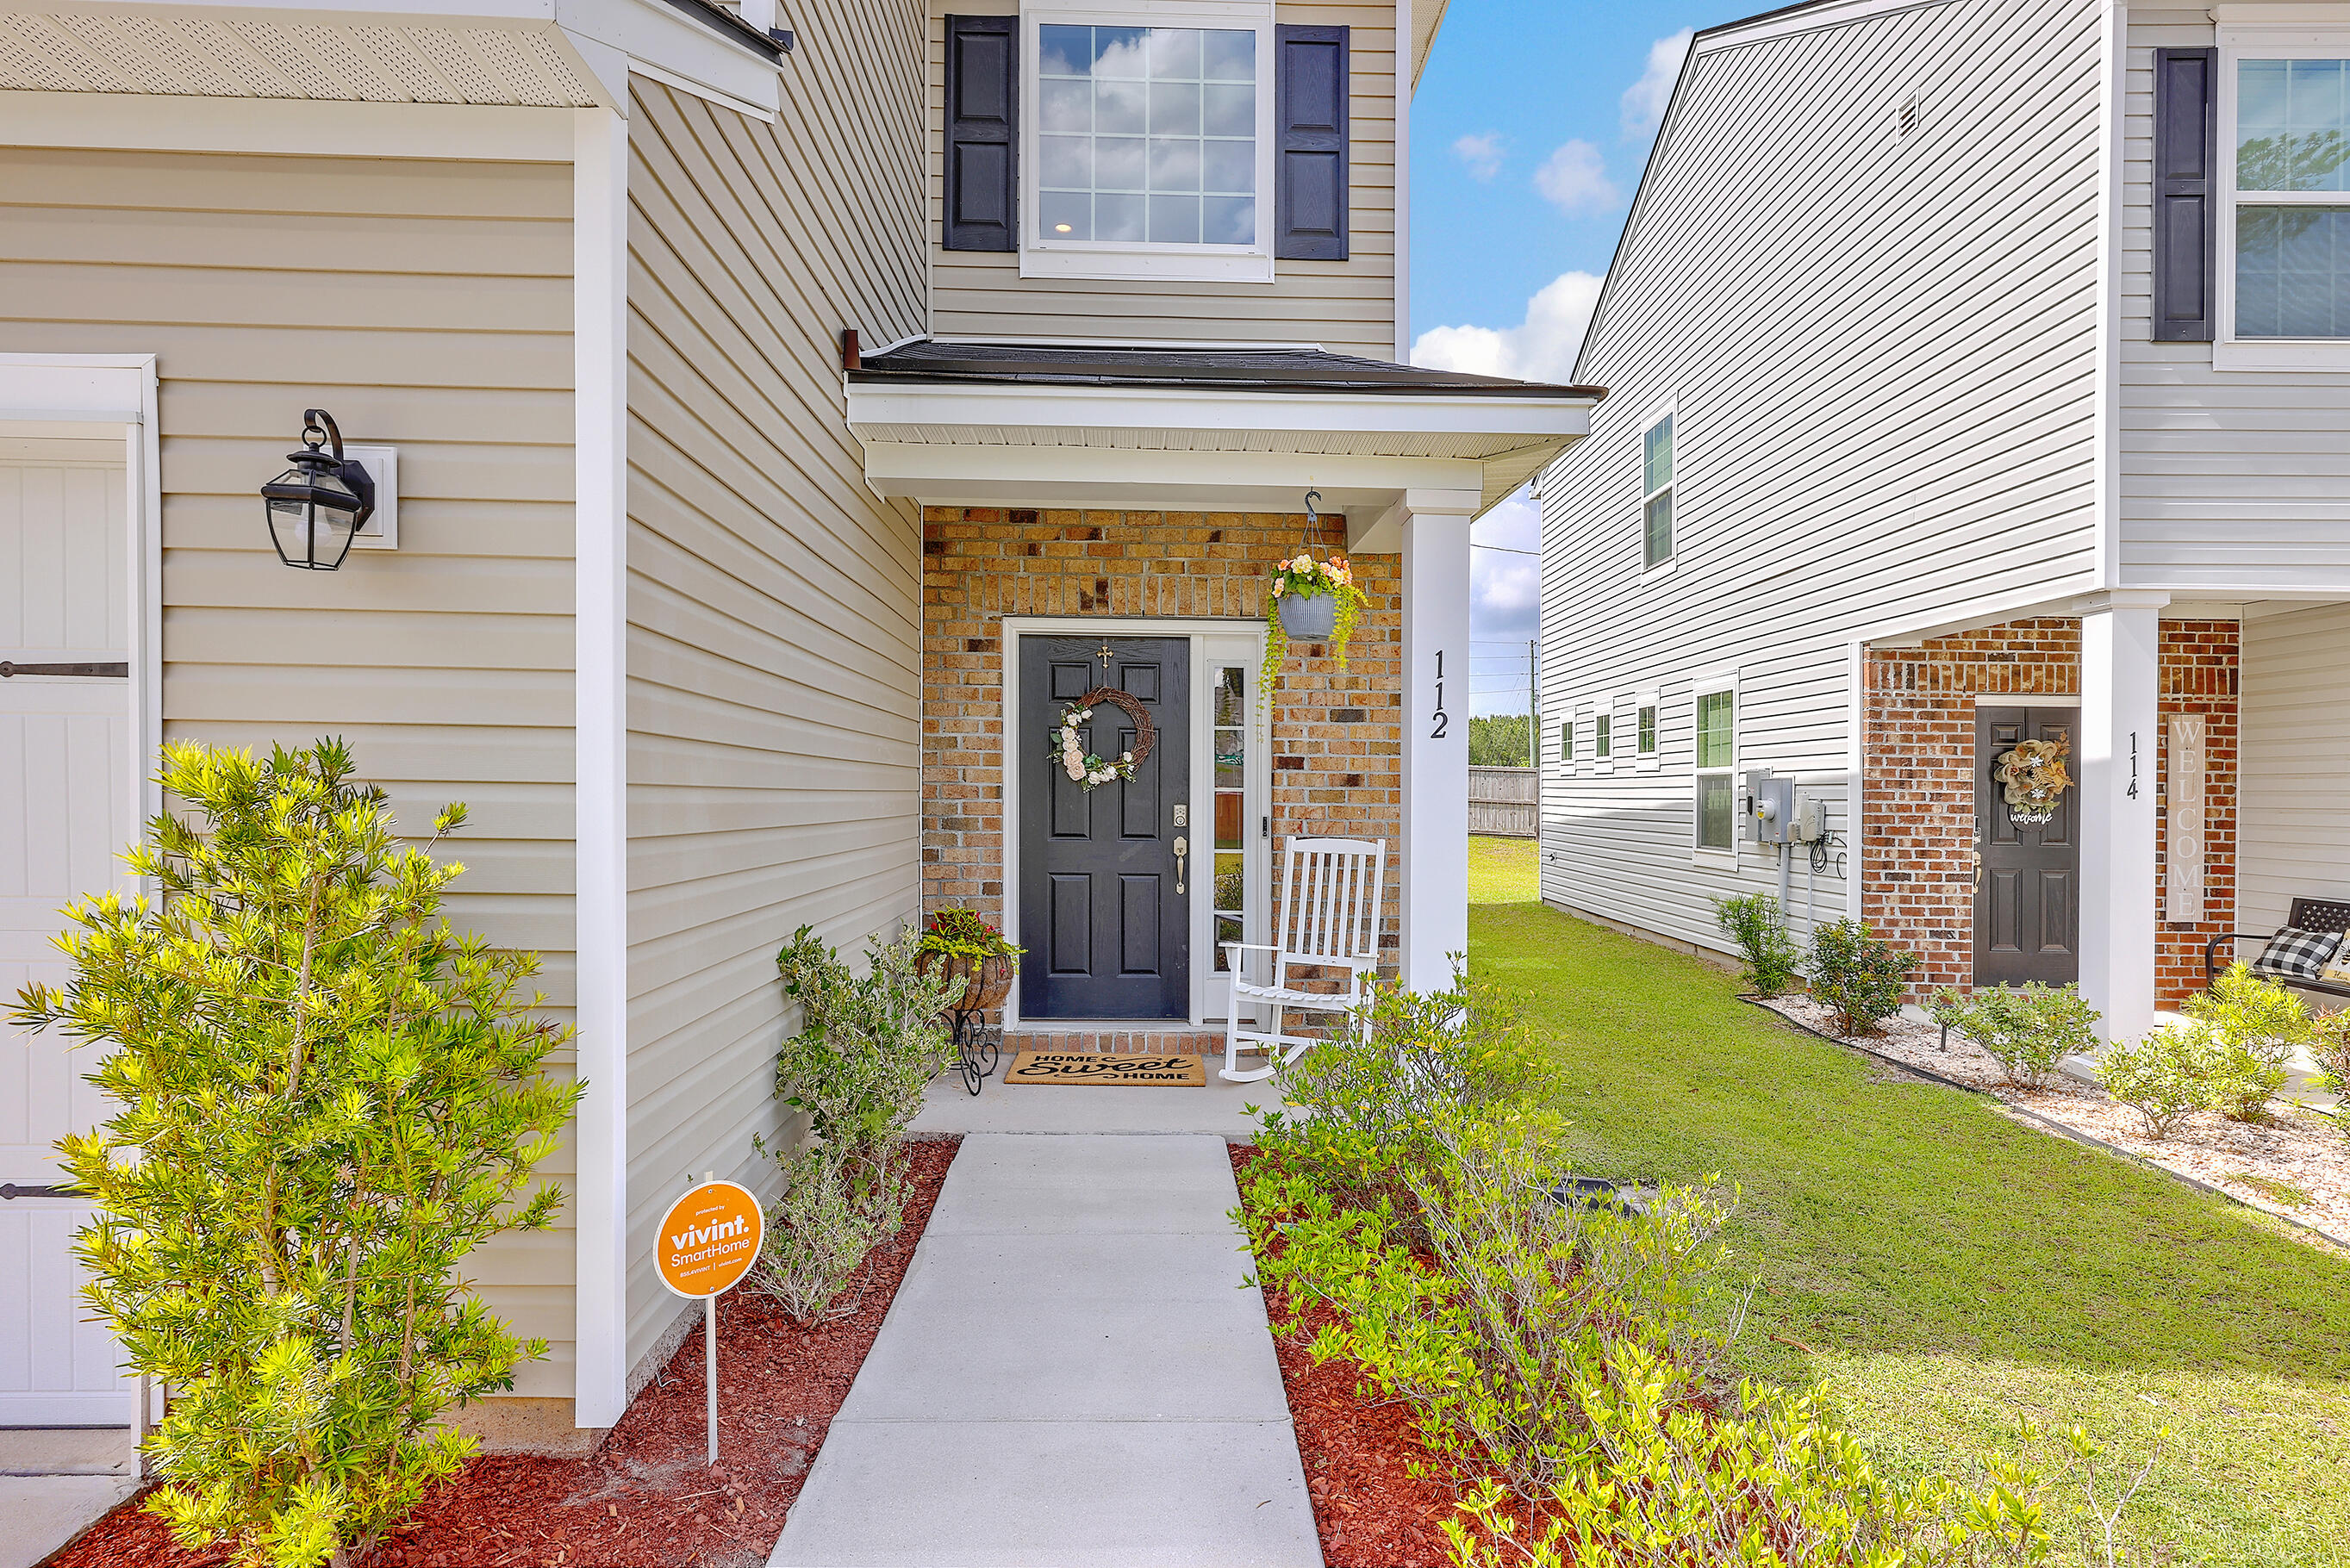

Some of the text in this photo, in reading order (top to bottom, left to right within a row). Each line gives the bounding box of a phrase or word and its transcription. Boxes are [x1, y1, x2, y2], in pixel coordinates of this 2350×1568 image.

[1431, 650, 1448, 738] 112
[2127, 731, 2138, 800] 114
[2010, 812, 2053, 824] welcome
[2172, 721, 2203, 916] WELCOME
[1017, 1057, 1194, 1076] Sweet
[695, 1206, 718, 1216] protected
